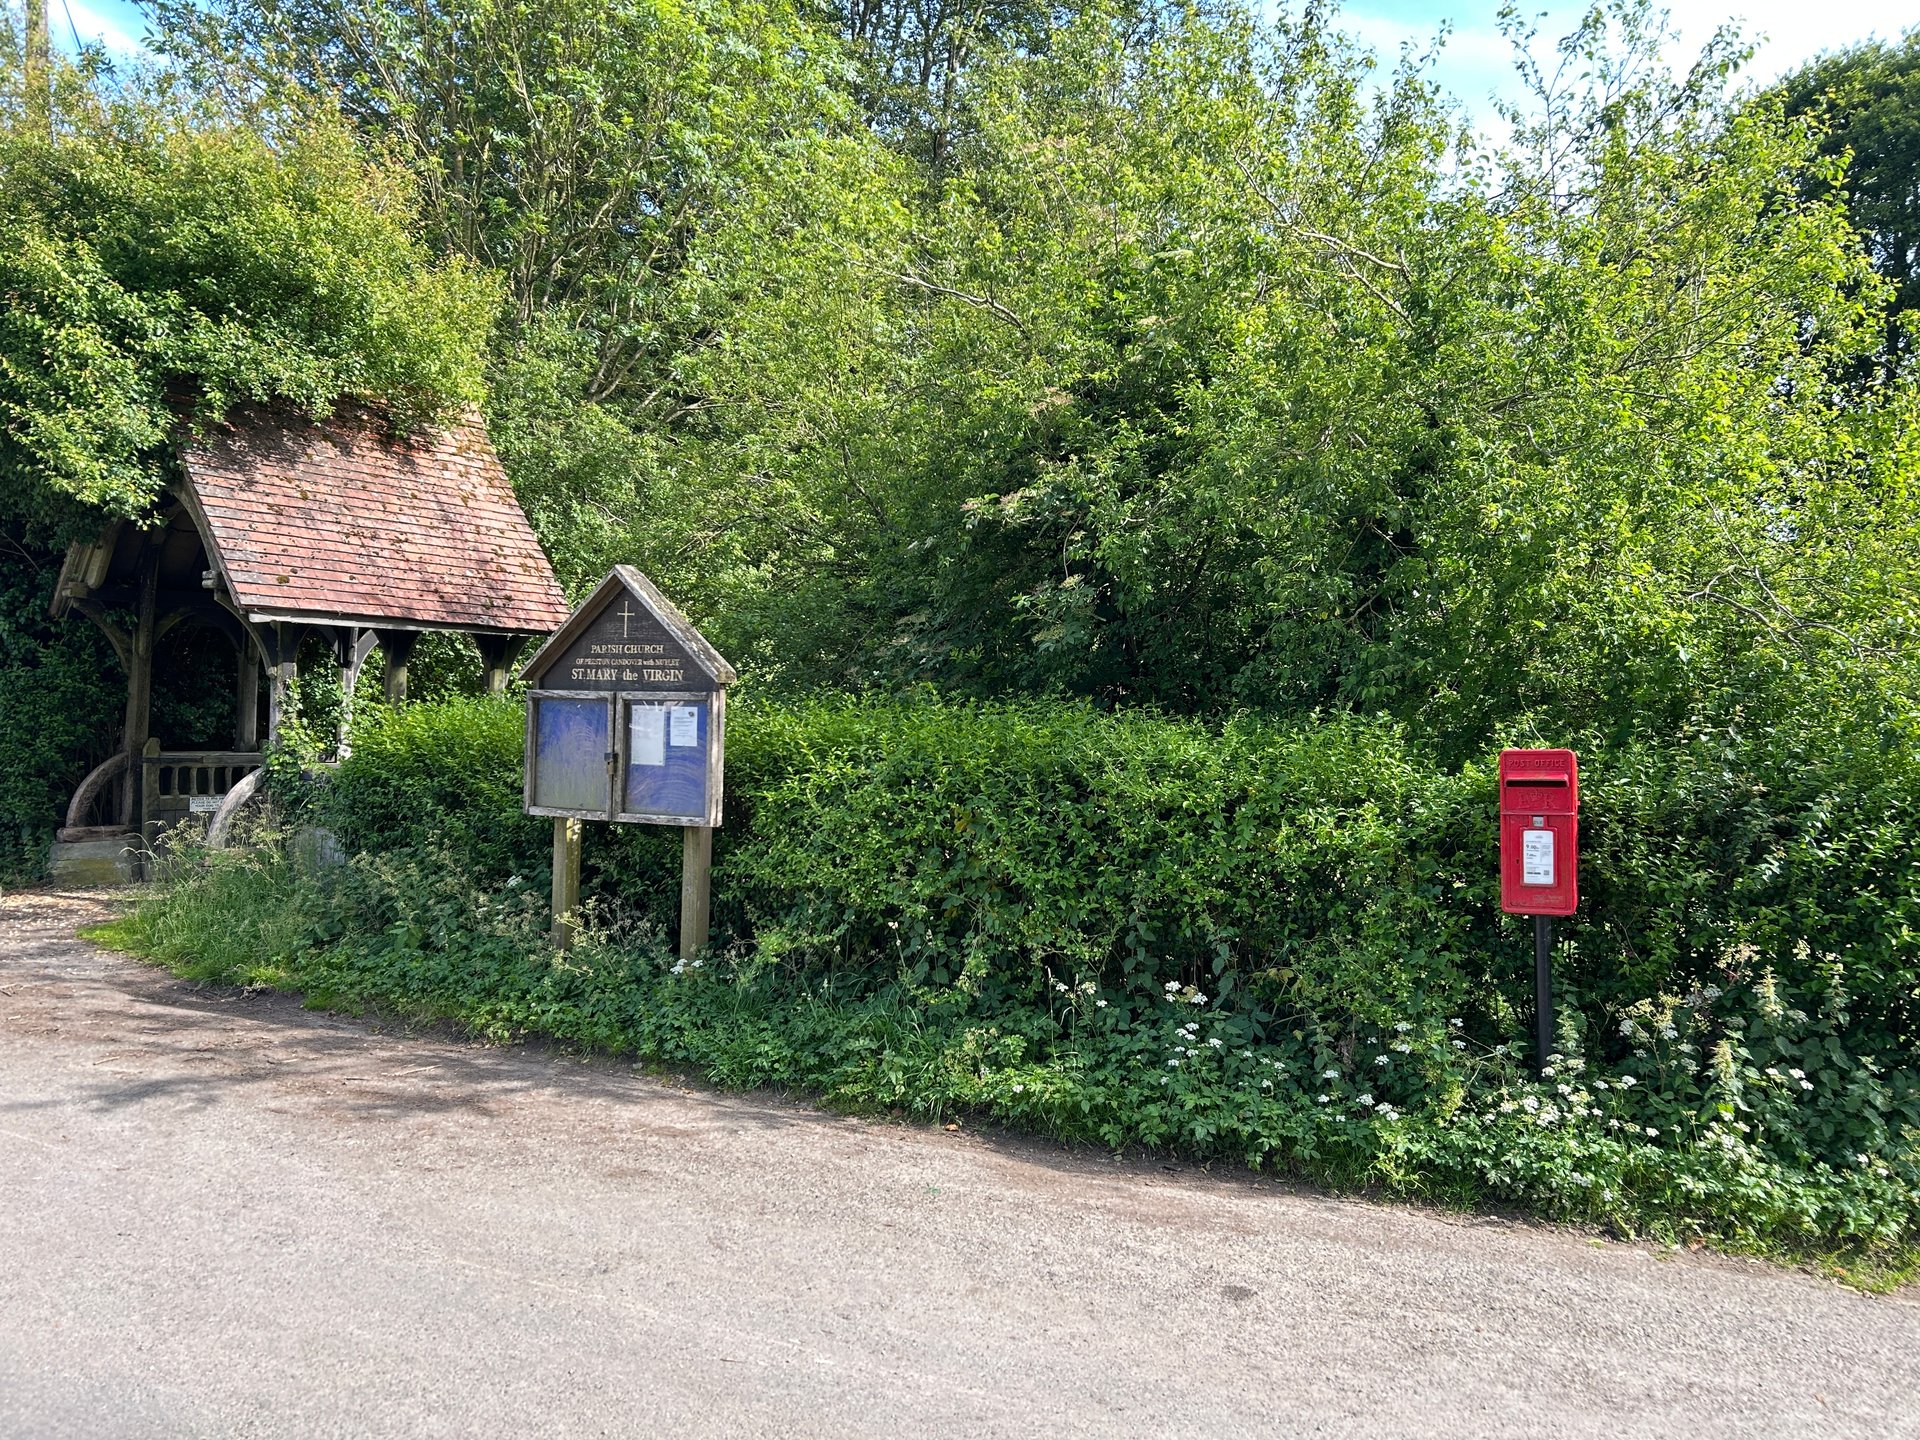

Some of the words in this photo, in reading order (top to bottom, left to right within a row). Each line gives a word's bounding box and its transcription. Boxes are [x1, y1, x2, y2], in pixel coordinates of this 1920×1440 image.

[591, 644, 623, 654] PARISH
[624, 644, 664, 654] CHURCH
[623, 668, 638, 681] the
[643, 669, 684, 682] VIRGIN
[1509, 759, 1531, 767] POST
[1535, 759, 1565, 767] OFFICE
